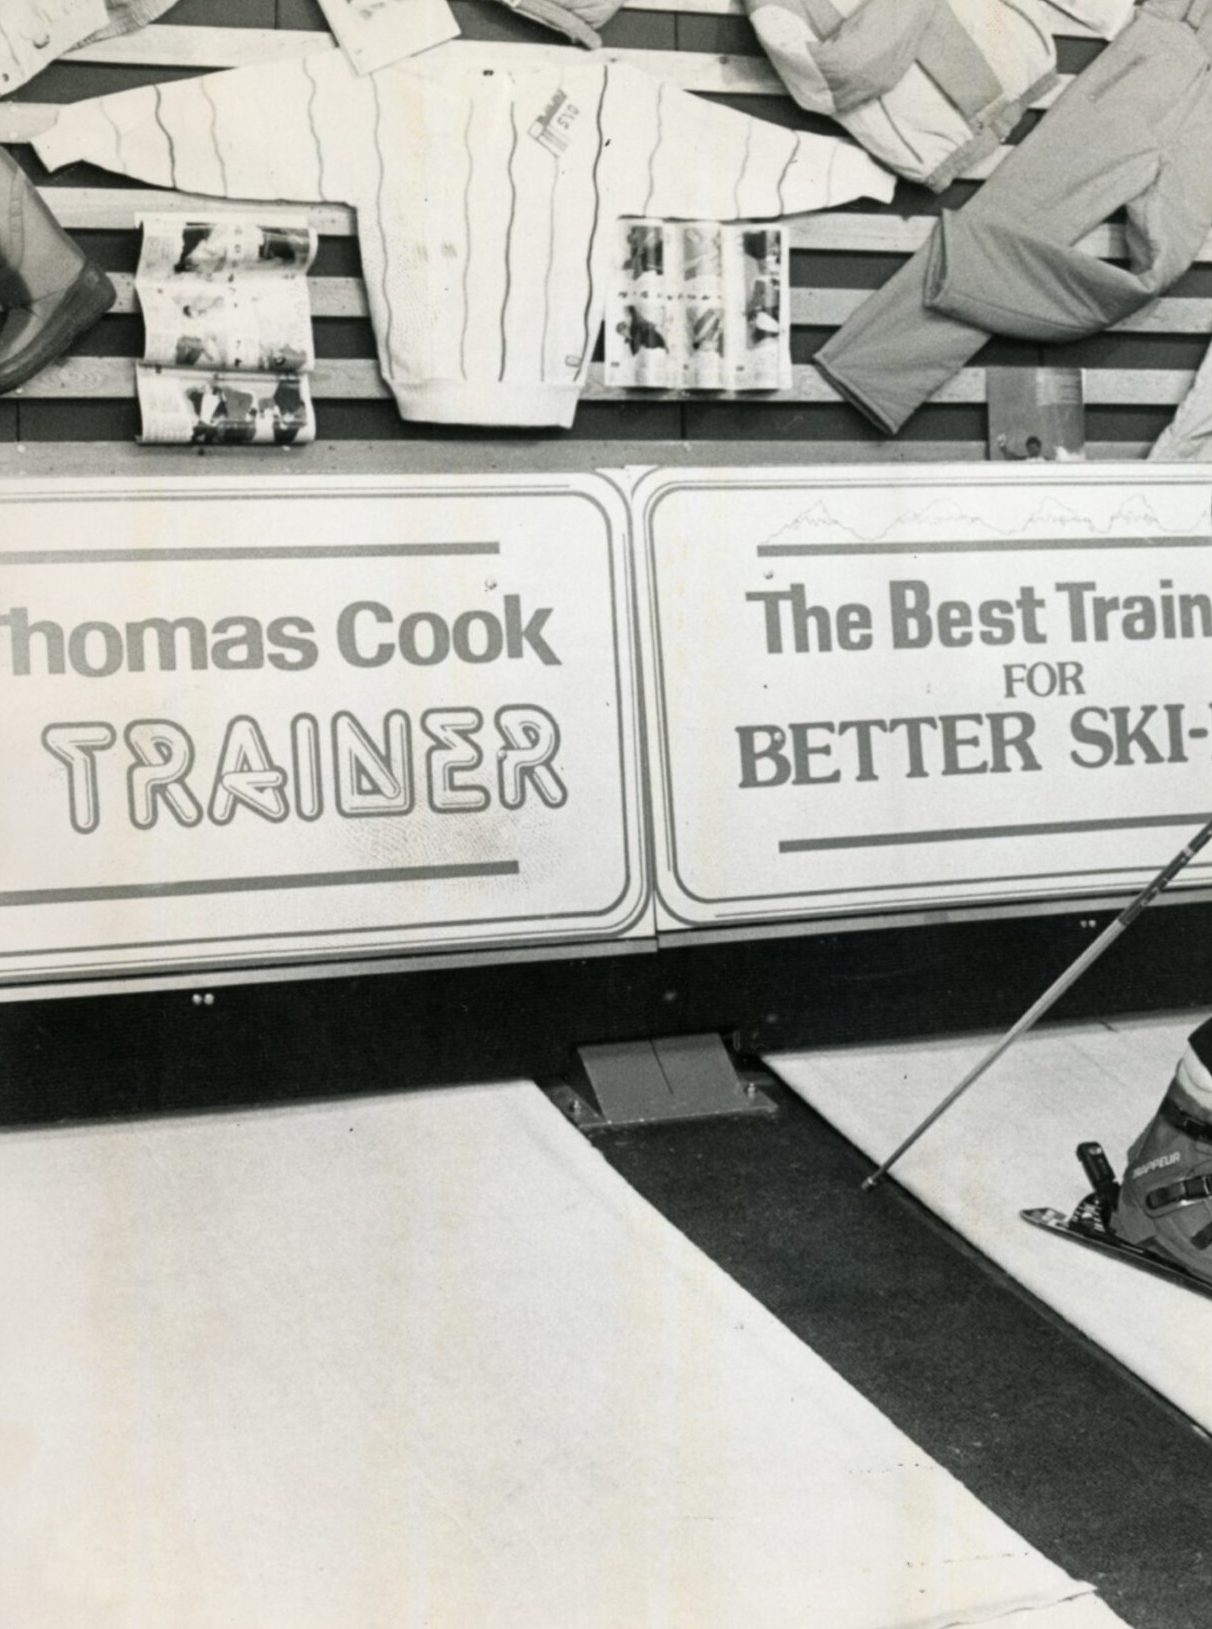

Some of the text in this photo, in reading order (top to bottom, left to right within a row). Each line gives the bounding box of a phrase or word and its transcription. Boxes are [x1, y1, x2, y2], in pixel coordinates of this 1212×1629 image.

[0, 594, 562, 678] homas Cook
[745, 583, 873, 654] The
[889, 580, 1047, 649] Best
[1003, 661, 1086, 698] FOR
[41, 703, 569, 835] TRAINER
[735, 711, 1042, 789] BETTER
